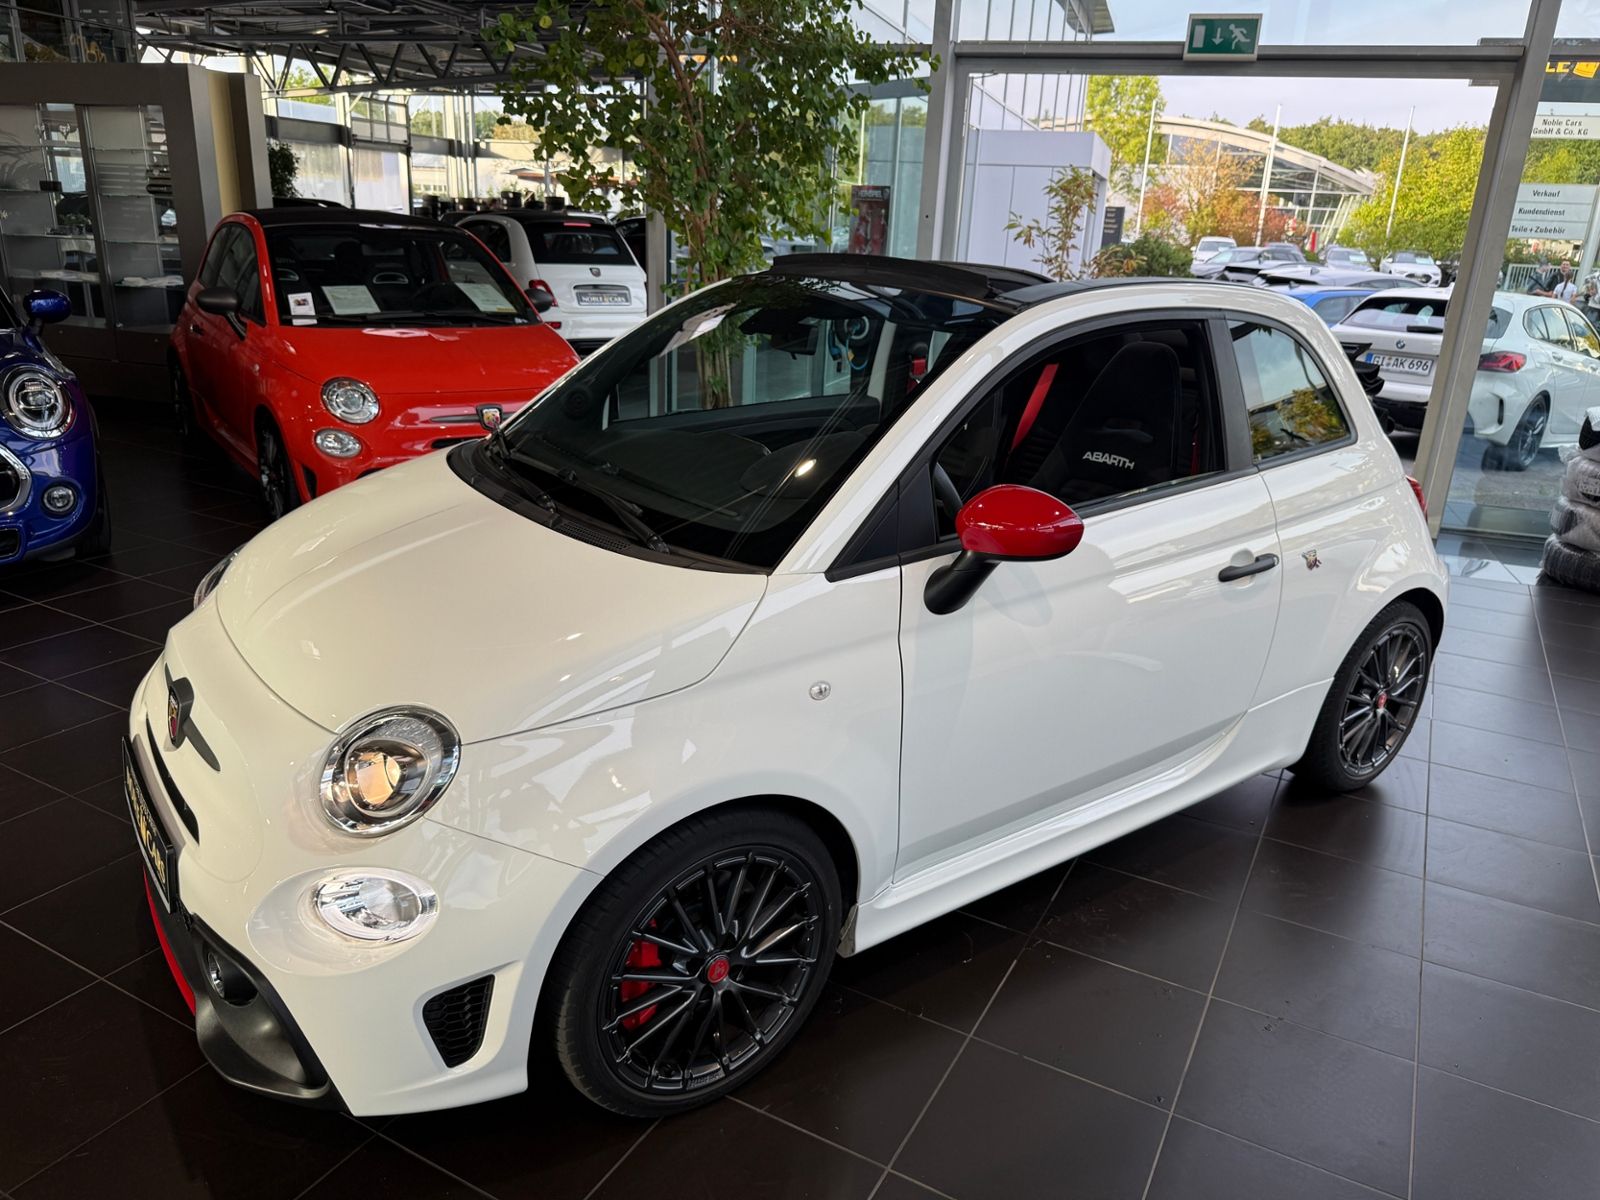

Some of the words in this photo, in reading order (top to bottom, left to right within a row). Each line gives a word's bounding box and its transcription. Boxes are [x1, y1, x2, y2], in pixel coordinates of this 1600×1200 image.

[1542, 118, 1563, 126] Noble
[1565, 119, 1583, 127] Cars
[1532, 127, 1554, 135] GmbH
[1555, 127, 1561, 135] &
[1563, 128, 1575, 136] Co.
[1577, 128, 1589, 136] KG
[1532, 189, 1561, 198] Verkauf
[1518, 207, 1566, 217] Kundendienst
[1511, 224, 1528, 233] Teile
[1534, 225, 1566, 235] Zubehör
[1391, 358, 1407, 368] AK
[1407, 360, 1429, 371] 696
[1082, 451, 1135, 470] ABARTH
